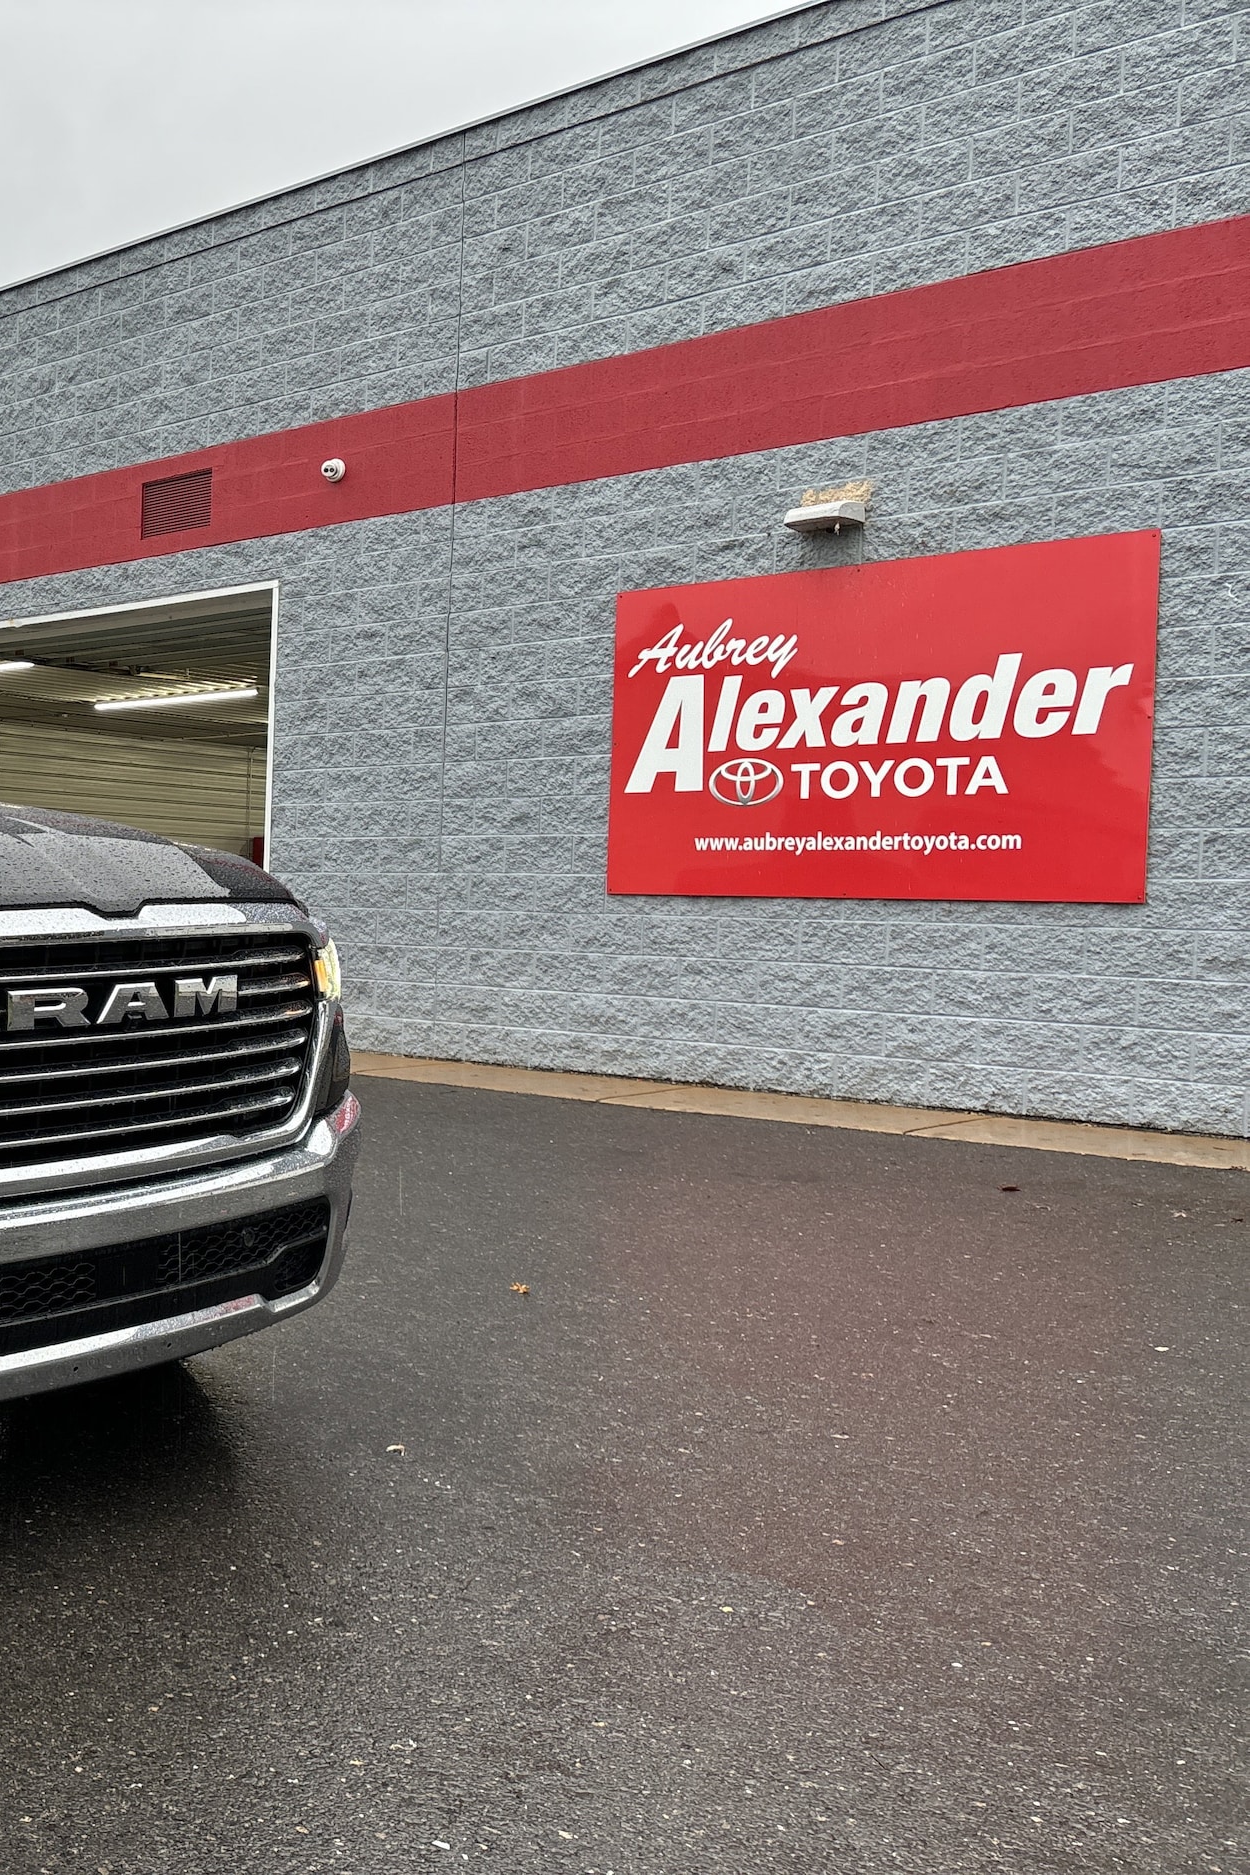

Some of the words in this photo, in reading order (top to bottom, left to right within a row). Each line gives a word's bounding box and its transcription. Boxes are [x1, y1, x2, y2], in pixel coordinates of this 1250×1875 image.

[628, 618, 798, 678] Aubrey
[624, 653, 1134, 794] Alexander
[791, 755, 1009, 799] TOYOTA
[694, 831, 1022, 856] www.aubreyalexandertoyota.com
[7, 975, 238, 1031] RAM
